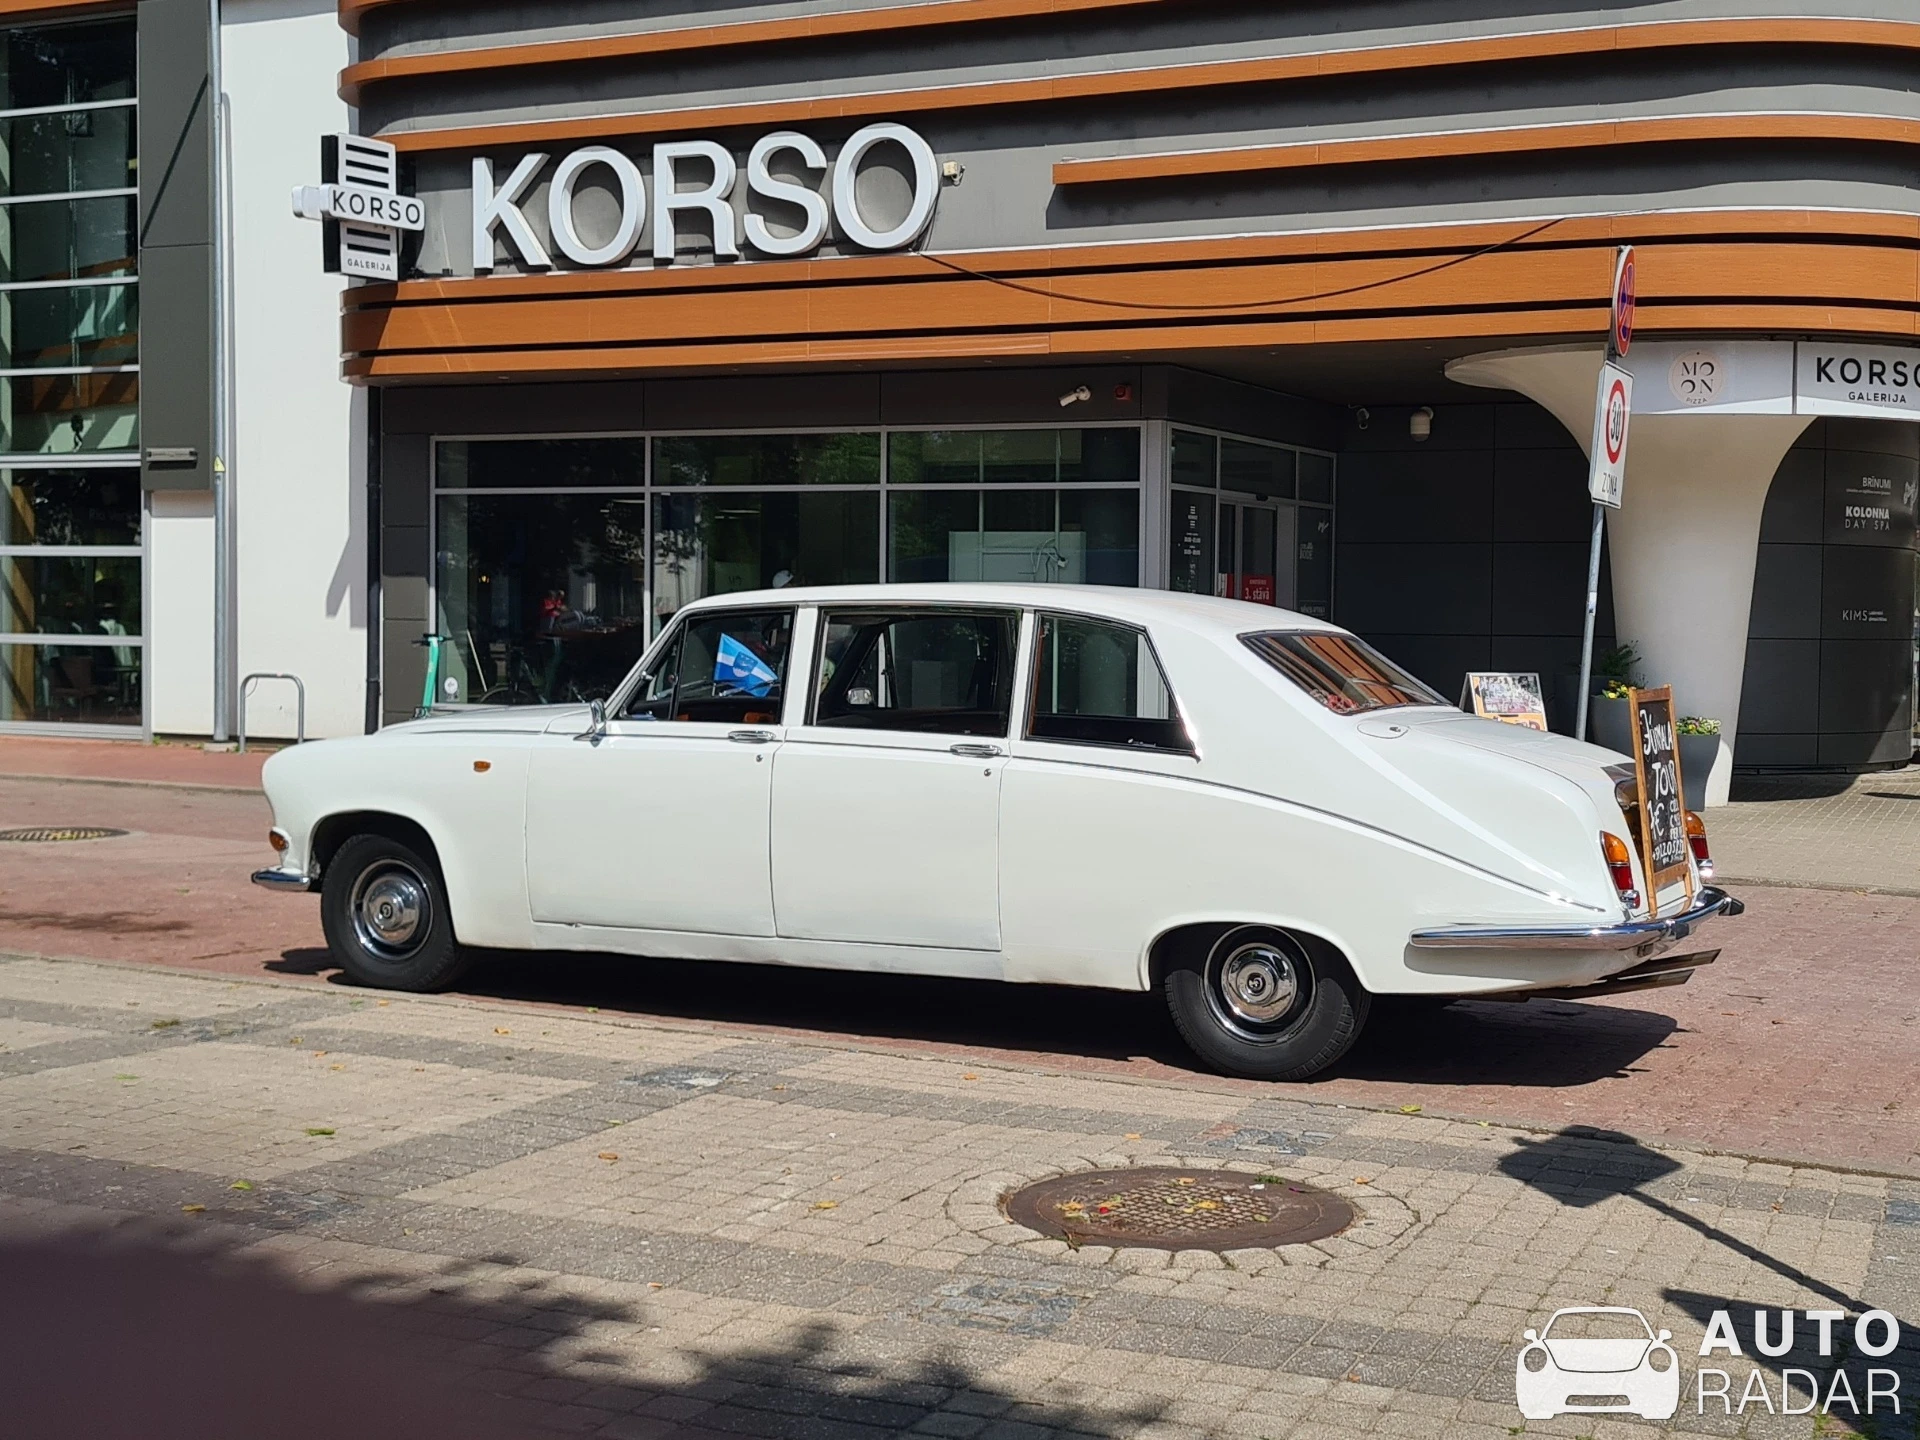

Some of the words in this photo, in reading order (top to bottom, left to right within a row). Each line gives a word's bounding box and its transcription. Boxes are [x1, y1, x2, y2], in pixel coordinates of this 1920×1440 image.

[473, 123, 939, 269] KORSO
[333, 190, 420, 224] KORSO
[347, 258, 391, 272] GALERIJA
[1686, 397, 1707, 405] PIZZA
[1848, 391, 1906, 404] GALERIJA
[1611, 401, 1622, 442] 30
[1602, 472, 1618, 496] ZONA
[1862, 476, 1892, 489] BRĪNUMI
[1845, 506, 1890, 519] KOLONNA
[1845, 519, 1867, 529] DAY
[1874, 520, 1890, 531] SPA
[1842, 609, 1868, 622] KIMS
[1652, 759, 1678, 800] TOUR
